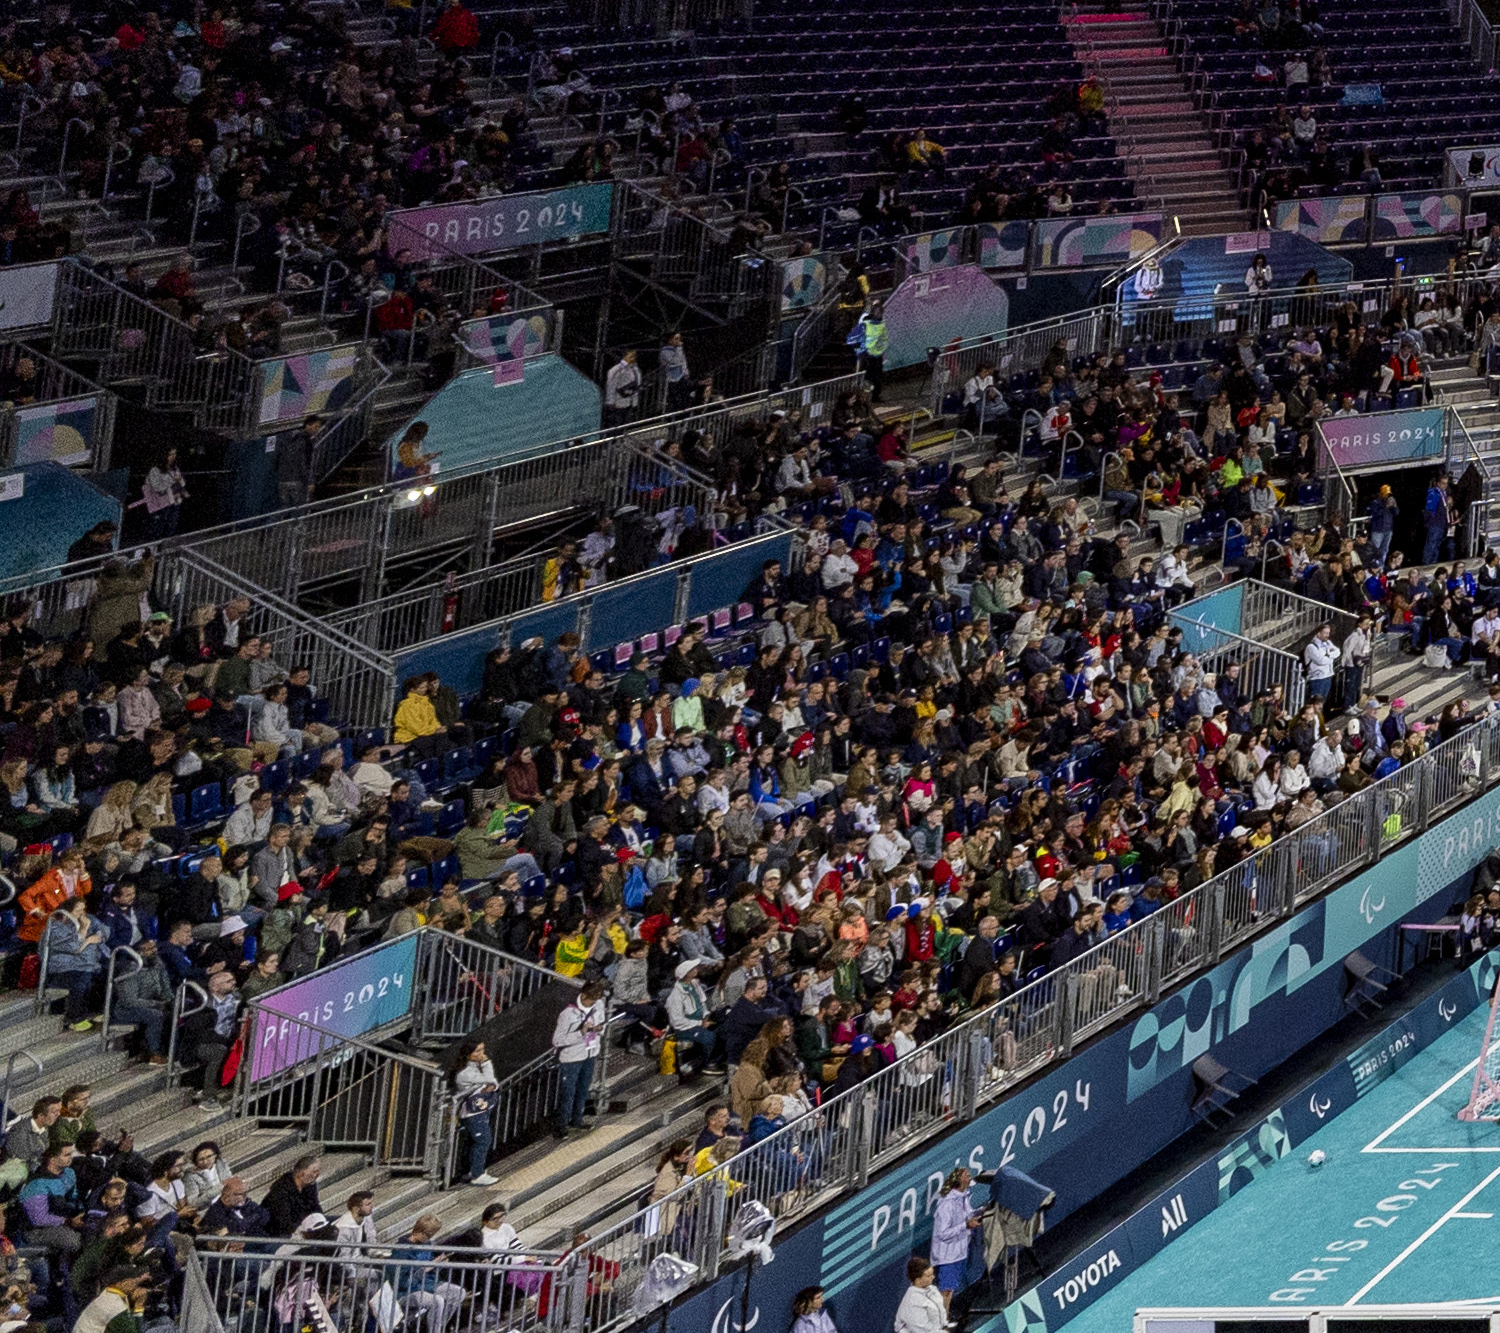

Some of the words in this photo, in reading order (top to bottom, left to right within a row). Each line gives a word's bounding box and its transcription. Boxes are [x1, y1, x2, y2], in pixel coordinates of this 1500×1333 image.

[516, 201, 582, 233] 2024
[1388, 427, 1434, 442] 2024
[343, 973, 403, 1012] 2024
[1389, 1032, 1415, 1057] 2024
[871, 1145, 984, 1251] PARS
[1000, 1080, 1090, 1168] 2024
[1268, 1239, 1369, 1301] ARiS
[1354, 1163, 1459, 1228] 2024
[1053, 1249, 1122, 1309] TOYOTA
